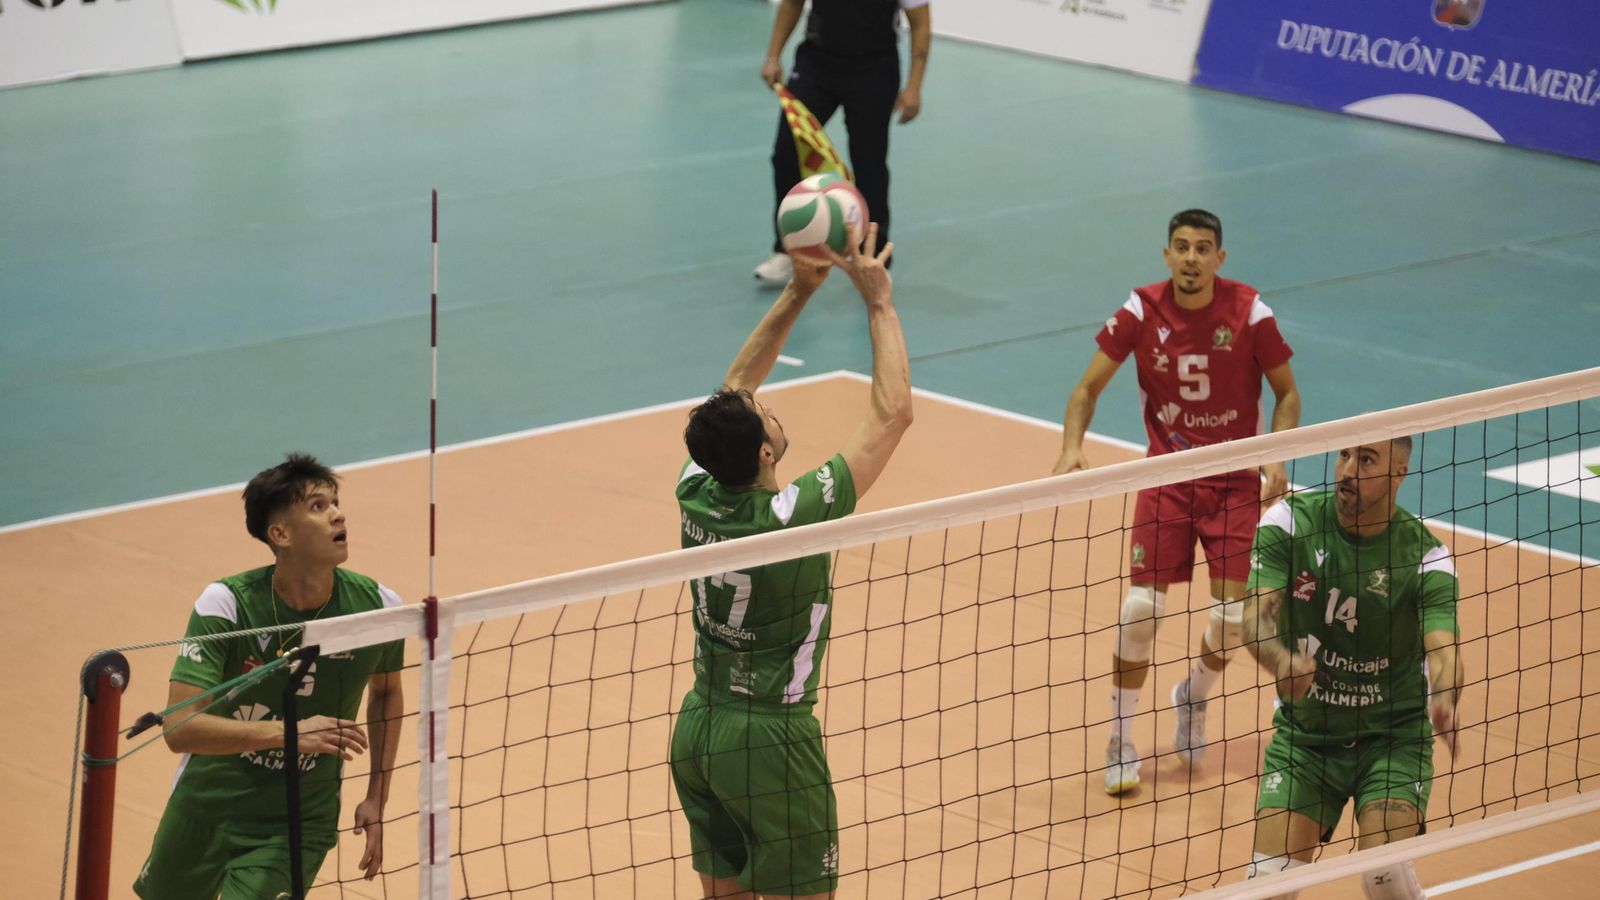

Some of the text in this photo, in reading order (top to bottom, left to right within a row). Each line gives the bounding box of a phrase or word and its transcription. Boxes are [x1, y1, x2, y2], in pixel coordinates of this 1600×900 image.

[1276, 19, 1445, 77] DIPUTACIÓN
[1446, 51, 1486, 85] DE
[1178, 354, 1211, 402] 5
[696, 571, 752, 629] 17
[1325, 587, 1359, 633] 14
[1323, 649, 1390, 676] Unicaja
